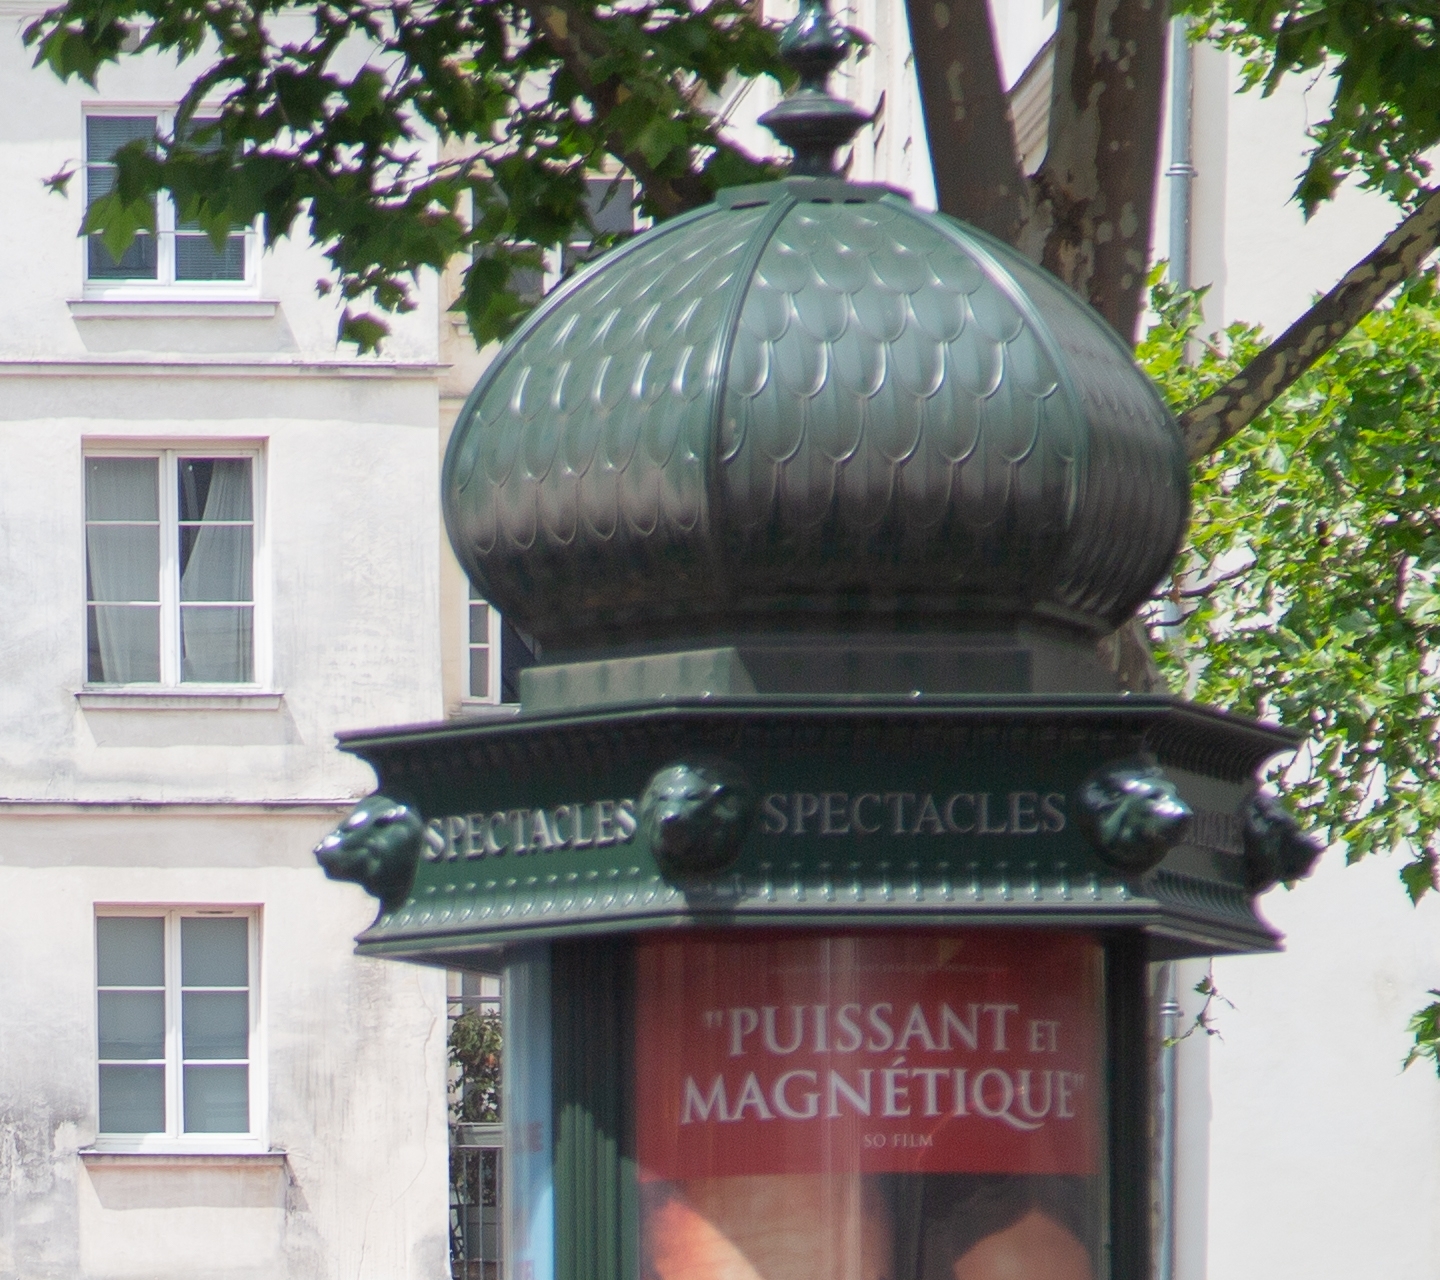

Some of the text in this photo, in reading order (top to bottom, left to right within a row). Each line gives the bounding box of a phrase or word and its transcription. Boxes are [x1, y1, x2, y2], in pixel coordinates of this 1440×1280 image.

[423, 799, 638, 862] SPECTACLES
[763, 793, 1066, 836] SPECTACLES
[704, 1002, 1061, 1057] "PUISSANT ET
[863, 1133, 934, 1148] SO FILM
